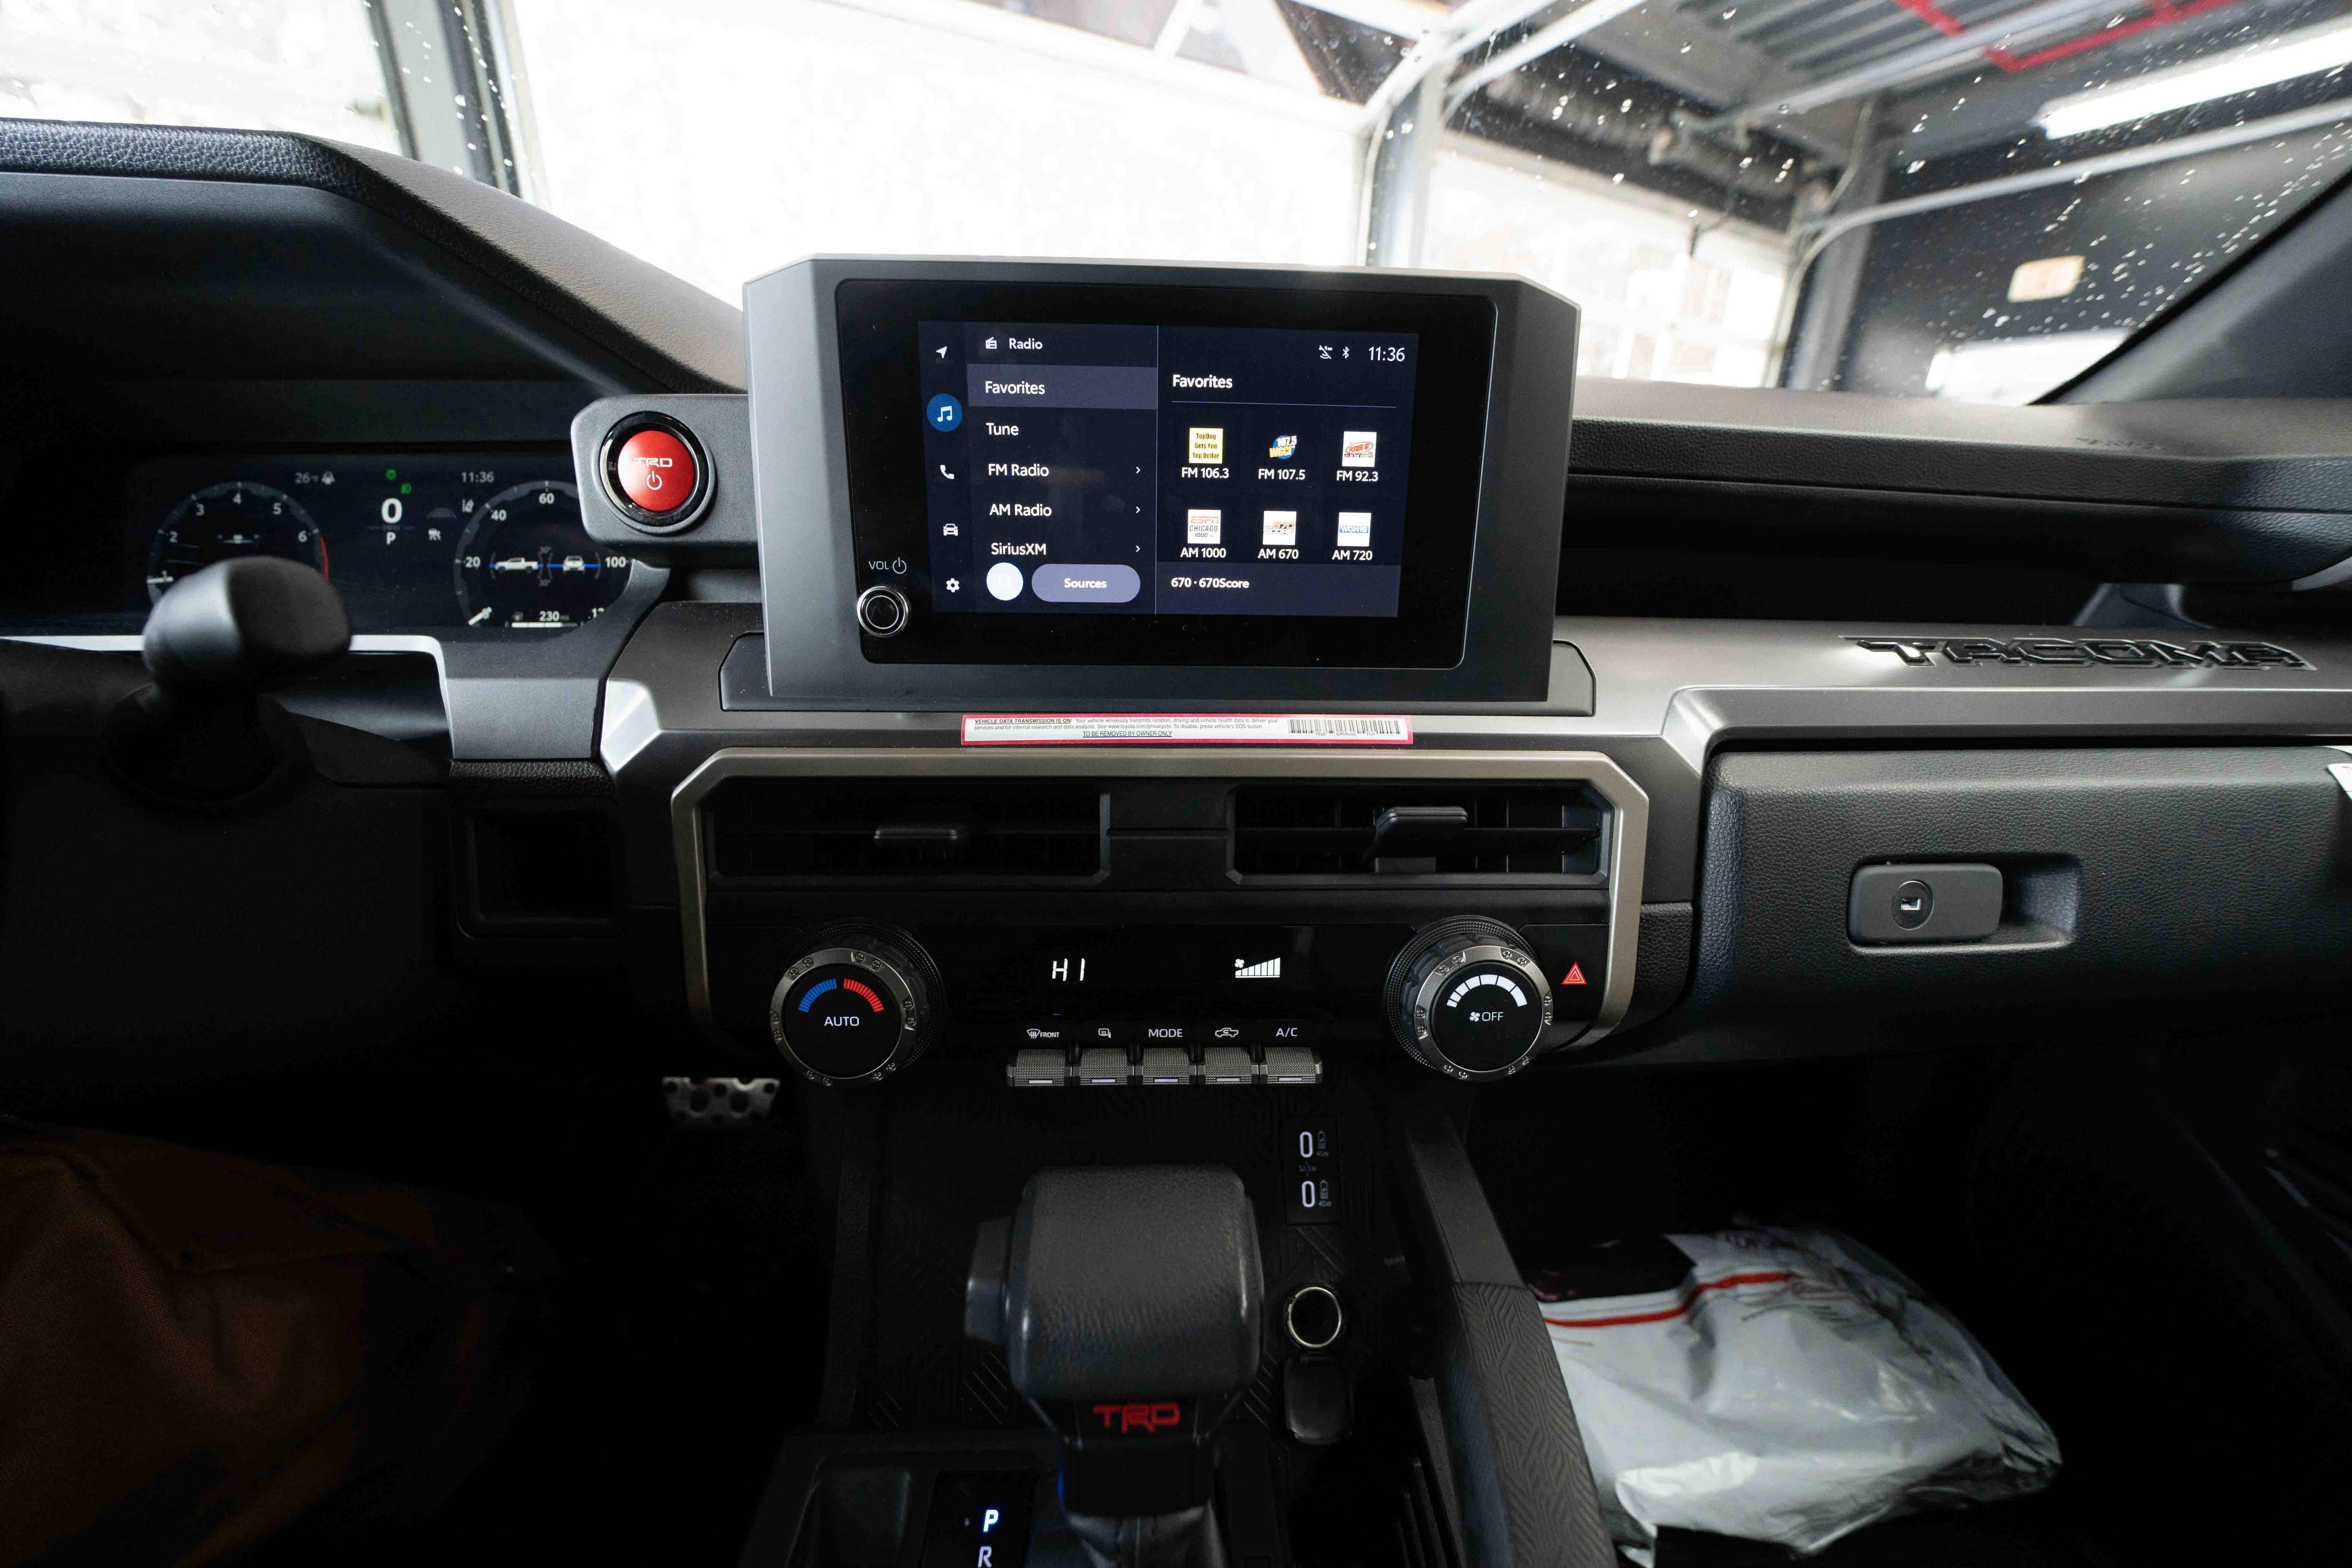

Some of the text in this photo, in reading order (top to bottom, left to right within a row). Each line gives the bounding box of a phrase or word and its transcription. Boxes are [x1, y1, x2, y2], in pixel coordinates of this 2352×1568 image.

[1009, 338, 1043, 350] Radio
[1368, 347, 1405, 362] 11:36
[1173, 374, 1233, 389] Favorites
[985, 381, 1045, 395] Favorites
[986, 423, 1019, 436] Tune
[633, 457, 673, 468] TRD
[988, 463, 1049, 477] FM Radio
[1181, 468, 1229, 479] FM 106.3
[1258, 469, 1305, 480] FM 107.5
[461, 472, 494, 483] 11:36
[1336, 470, 1379, 482] FM 92.3
[233, 493, 241, 504] 4
[539, 494, 555, 505] 60
[196, 504, 205, 516] 3
[273, 504, 281, 515] 5
[381, 497, 403, 524] 0
[989, 503, 1052, 517] AM Radio
[491, 510, 507, 521] 40
[169, 532, 177, 543] 2
[298, 530, 307, 542] 6
[386, 532, 396, 544] P
[991, 542, 1047, 556] SiriusXM
[1180, 547, 1226, 559] AM 1000
[1258, 548, 1298, 559] AM 670
[1332, 549, 1372, 561] AM 720
[466, 557, 481, 568] 20
[605, 557, 626, 568] 100
[868, 561, 889, 570] VOL
[1064, 578, 1107, 589] Sources
[1171, 578, 1250, 589] 670 670Score
[539, 611, 560, 621] 230
[1840, 635, 2317, 671] TACOMA
[824, 1016, 860, 1027] AUTO
[1481, 1011, 1504, 1021] OFF
[1148, 1028, 1183, 1038] MODE
[1276, 1027, 1298, 1038] A/C
[1093, 1403, 1180, 1434] TRD
[983, 1509, 999, 1532] P
[977, 1546, 992, 1568] R
